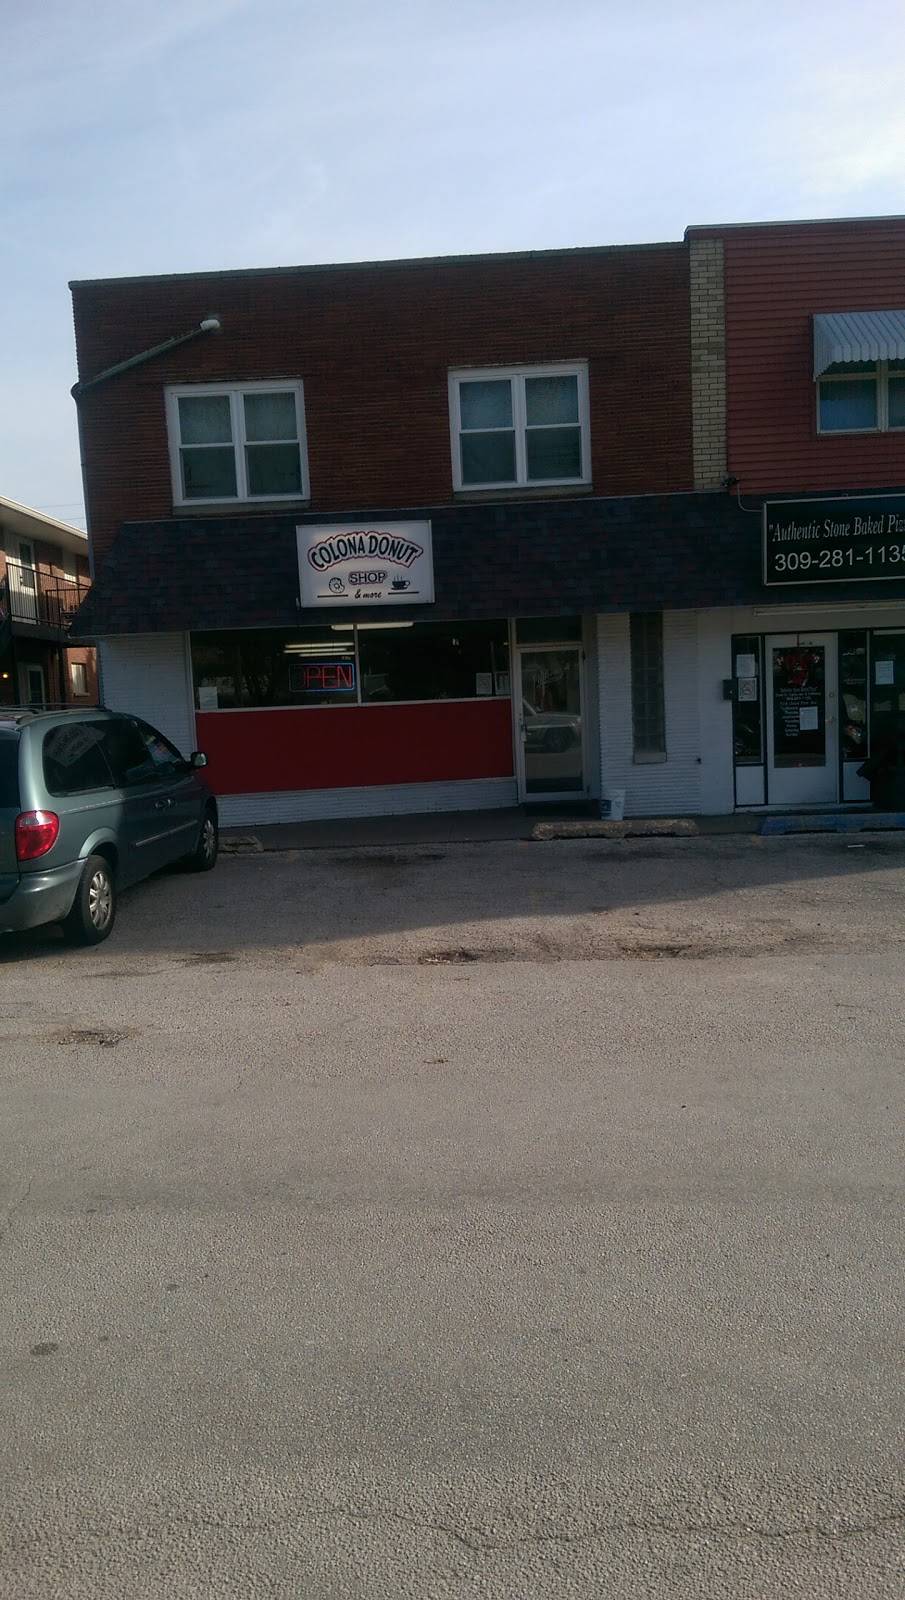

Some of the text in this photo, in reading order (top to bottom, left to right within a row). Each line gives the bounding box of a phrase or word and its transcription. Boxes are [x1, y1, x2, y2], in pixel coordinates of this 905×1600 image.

[768, 513, 905, 542] "Authentic Stone Baked Piz
[311, 535, 419, 568] COLONA DONUT
[349, 572, 386, 584] SHOP
[354, 588, 382, 600] & more
